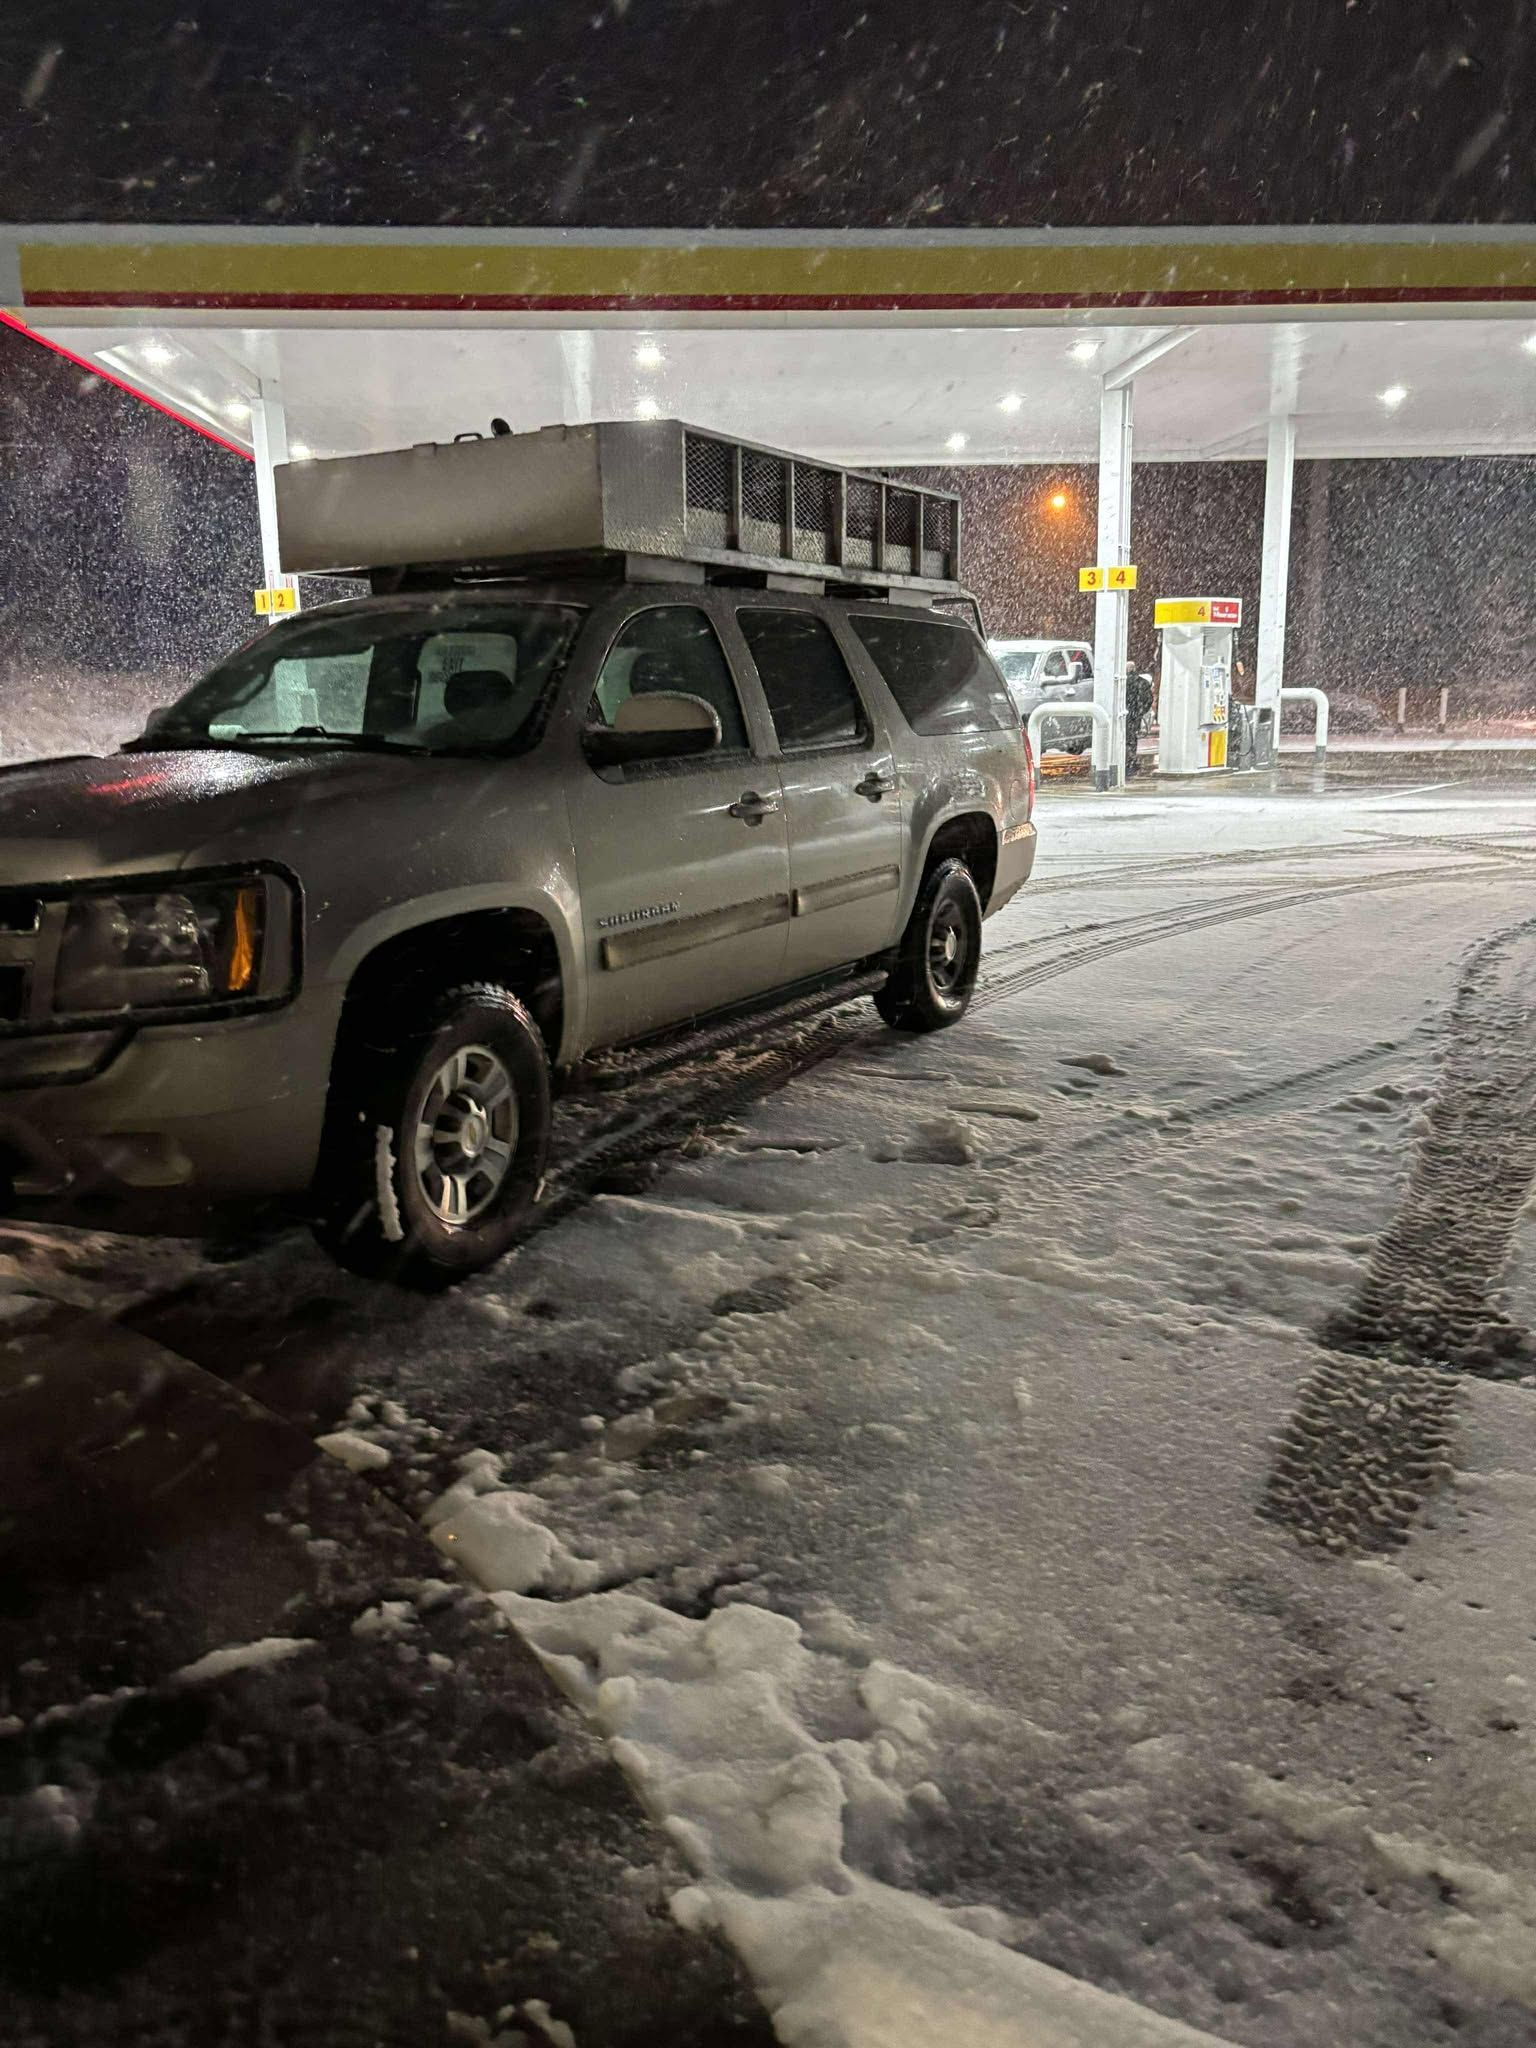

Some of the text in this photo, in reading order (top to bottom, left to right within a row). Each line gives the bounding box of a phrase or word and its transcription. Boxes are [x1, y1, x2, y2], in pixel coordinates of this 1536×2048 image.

[1087, 571, 1097, 586] 3
[1115, 570, 1126, 585] 4
[261, 594, 266, 609] 1
[277, 593, 285, 608] 2
[1197, 606, 1206, 617] 4
[597, 901, 680, 928] SUBURBAN
